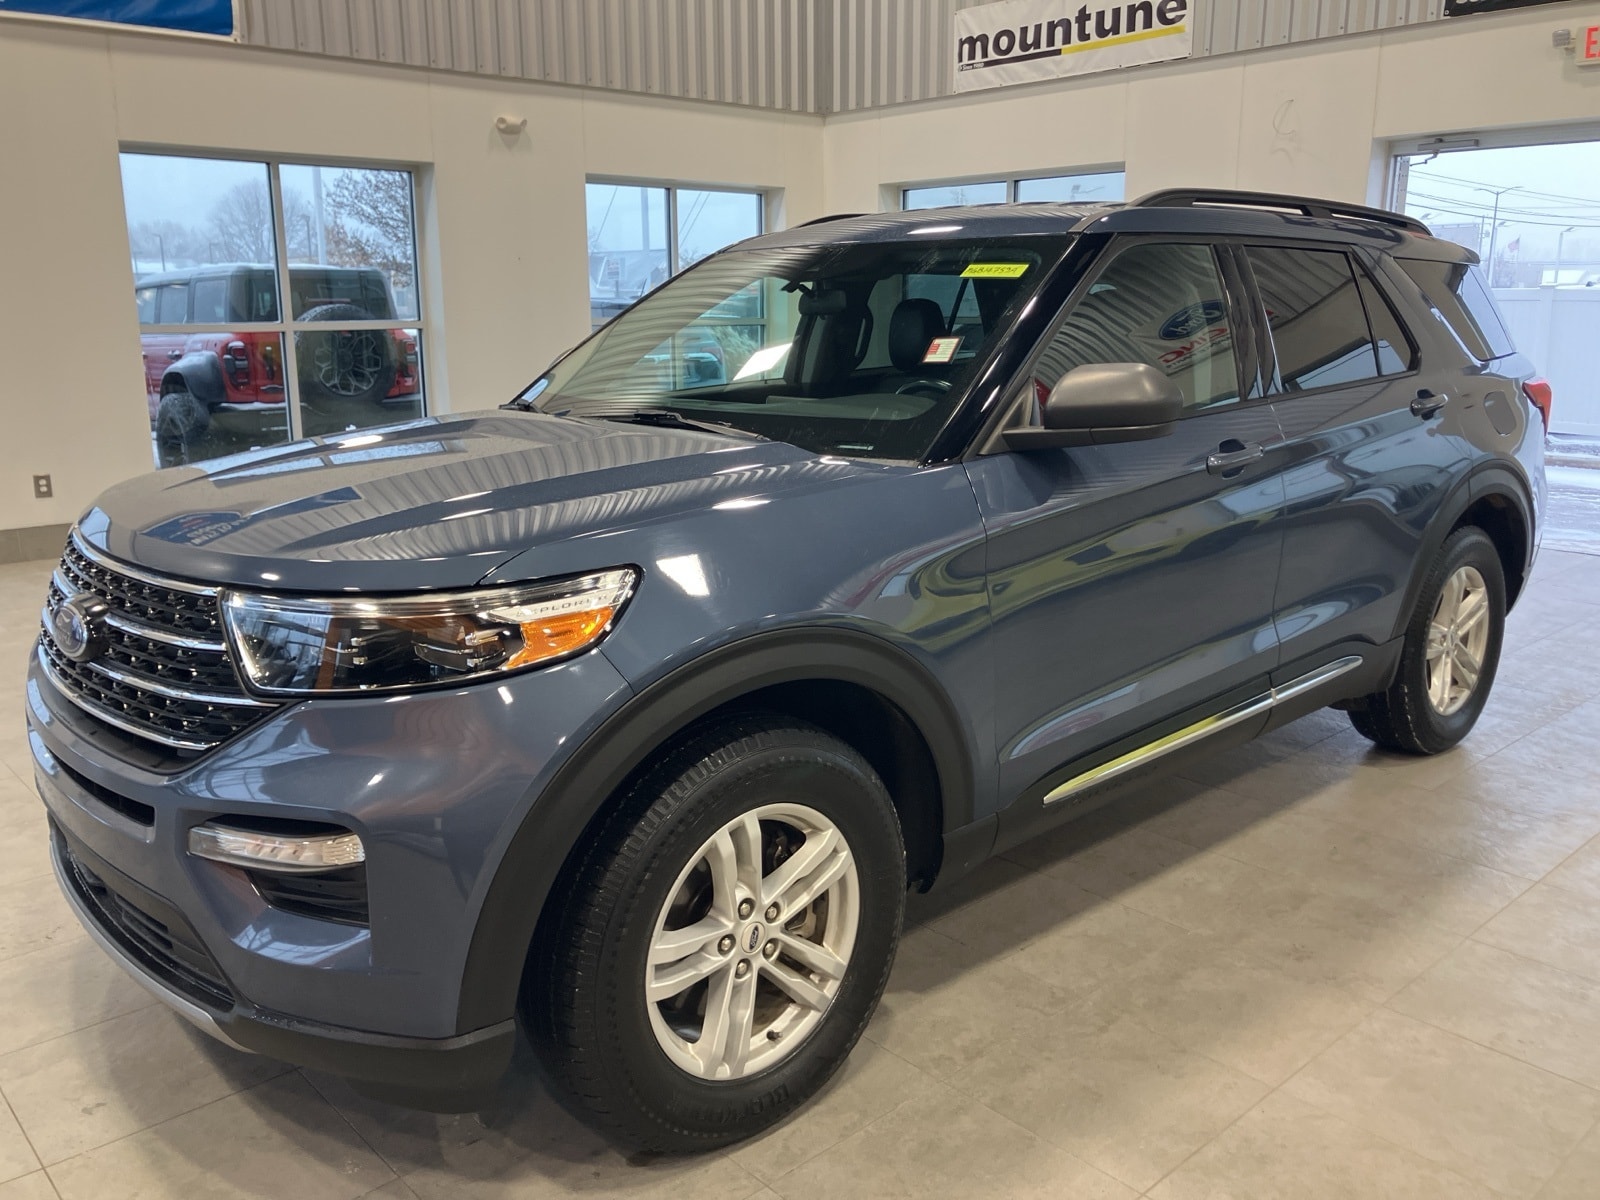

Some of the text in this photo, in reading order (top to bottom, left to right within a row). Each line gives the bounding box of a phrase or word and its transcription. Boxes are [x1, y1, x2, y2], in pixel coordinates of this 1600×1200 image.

[958, 0, 1187, 63] mountune
[1585, 26, 1600, 59] E
[516, 595, 608, 618] PLORR
